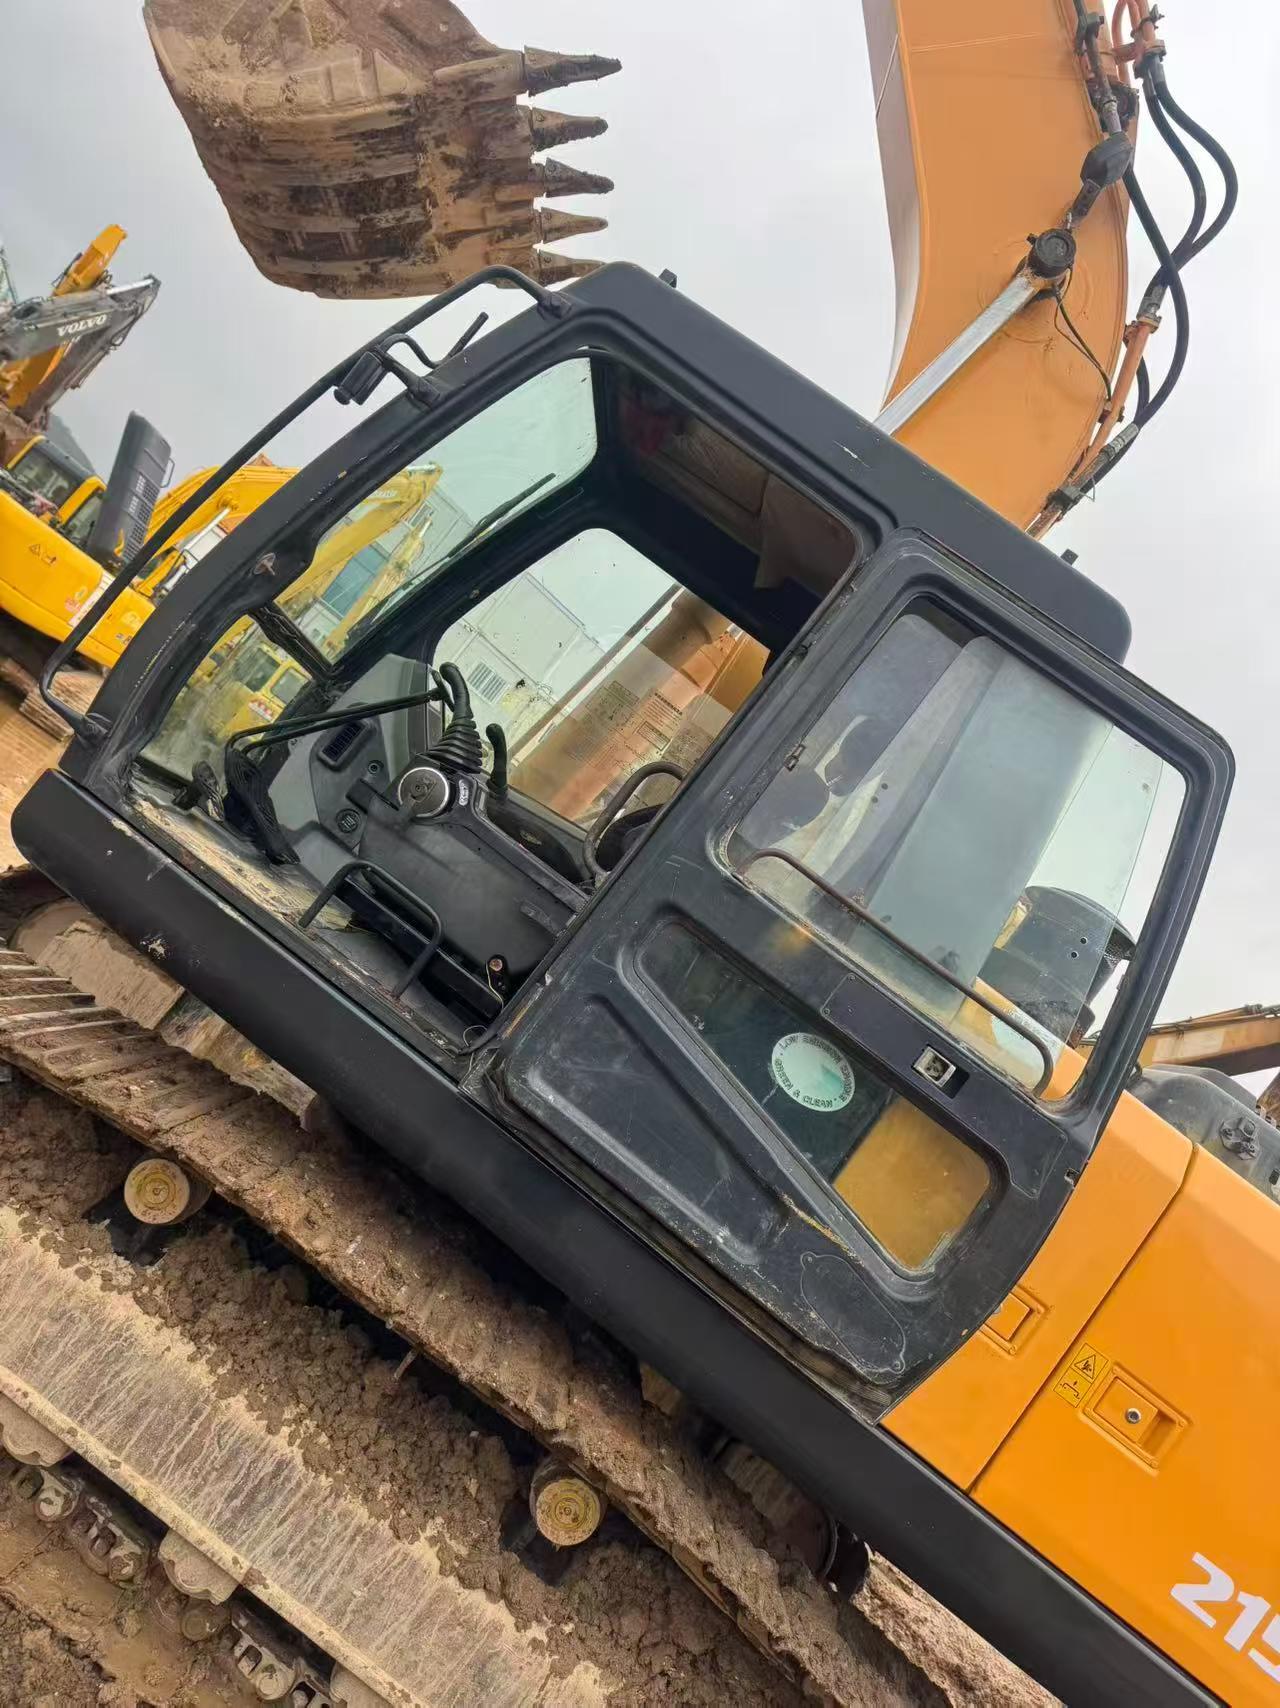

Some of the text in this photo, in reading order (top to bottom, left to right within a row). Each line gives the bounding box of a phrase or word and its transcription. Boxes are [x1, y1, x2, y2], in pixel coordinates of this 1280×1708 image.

[57, 314, 107, 337] VOLVO
[778, 1035, 798, 1050] LOW
[803, 1096, 833, 1109] CLEAN
